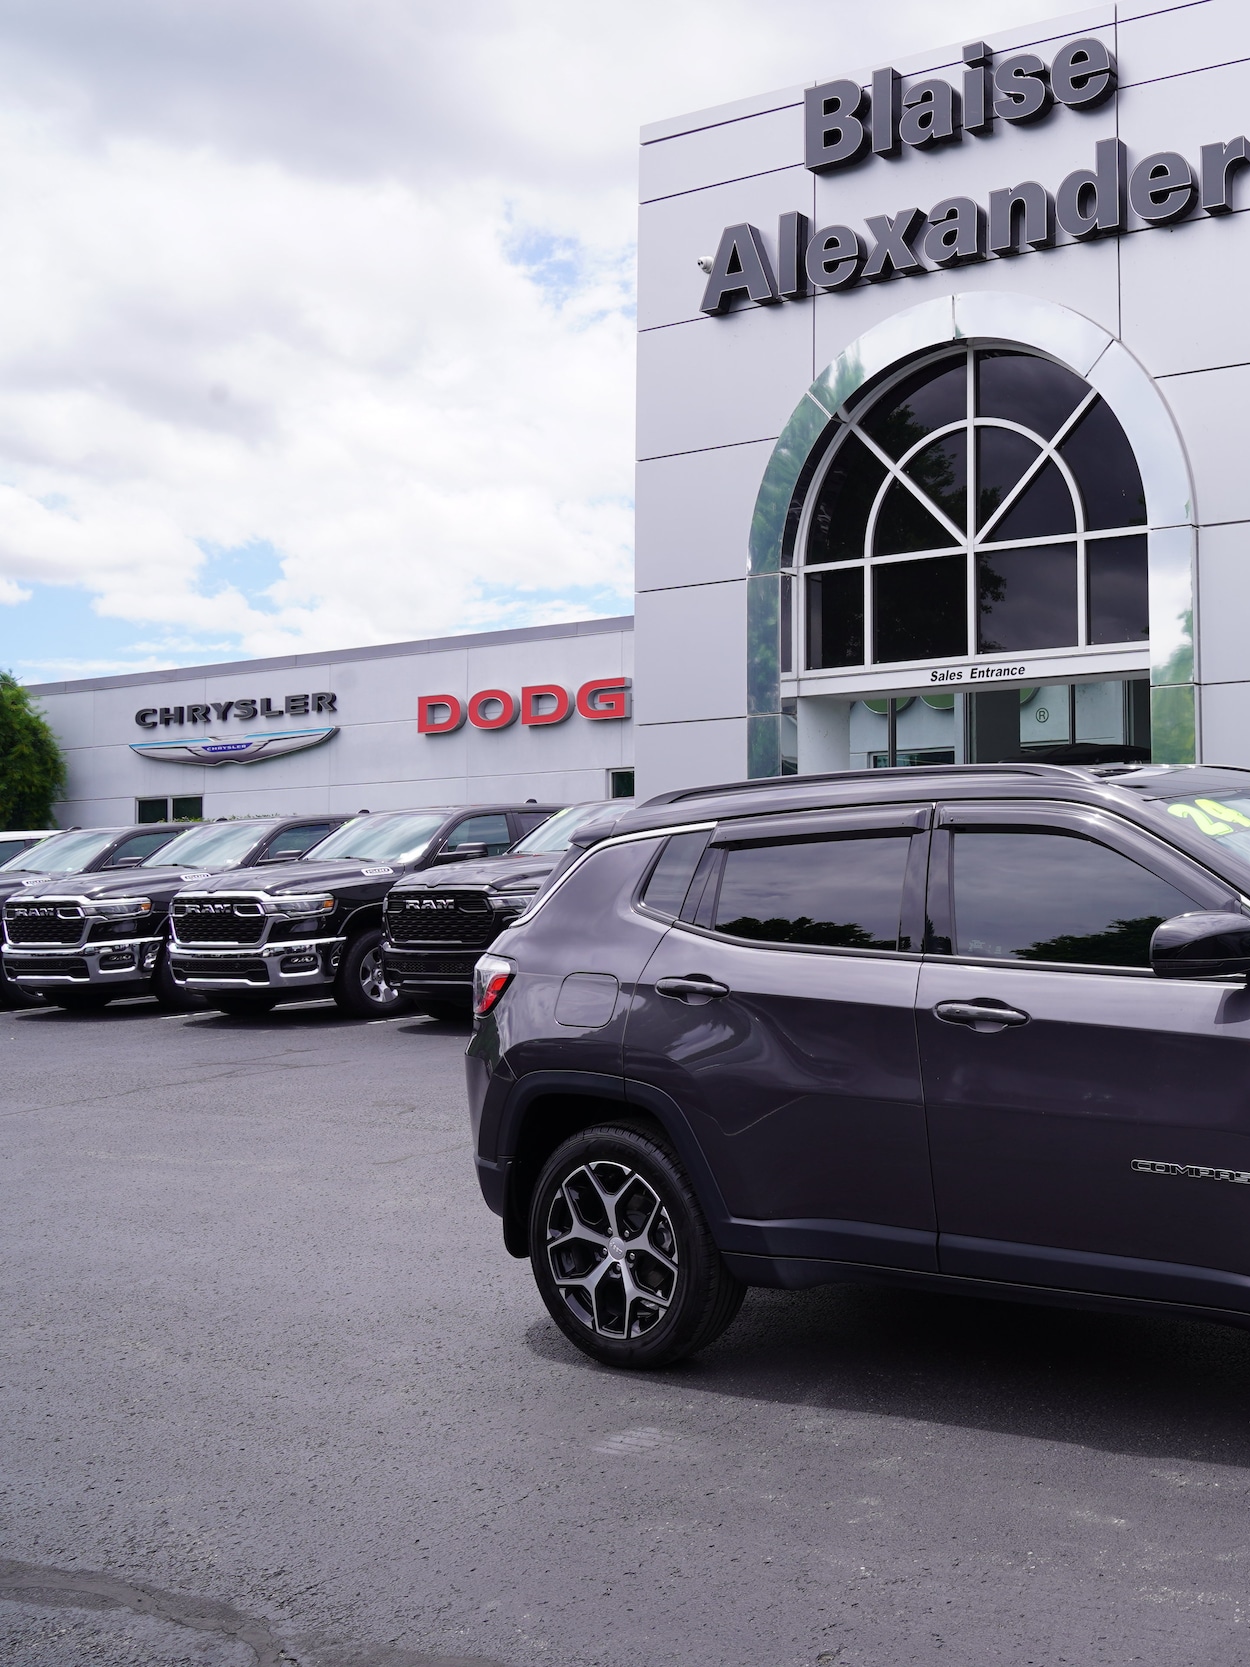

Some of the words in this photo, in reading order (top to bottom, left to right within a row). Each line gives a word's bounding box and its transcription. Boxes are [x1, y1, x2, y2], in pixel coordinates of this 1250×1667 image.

[803, 36, 1118, 175] Blaise
[930, 670, 963, 682] Sales
[970, 666, 1026, 679] Entrance
[135, 692, 338, 729] CHRYSLER
[417, 676, 632, 735] DODG
[206, 743, 247, 752] CHRYSLER
[186, 904, 232, 914] RAM
[405, 899, 455, 910] RAM
[15, 907, 54, 917] RAM
